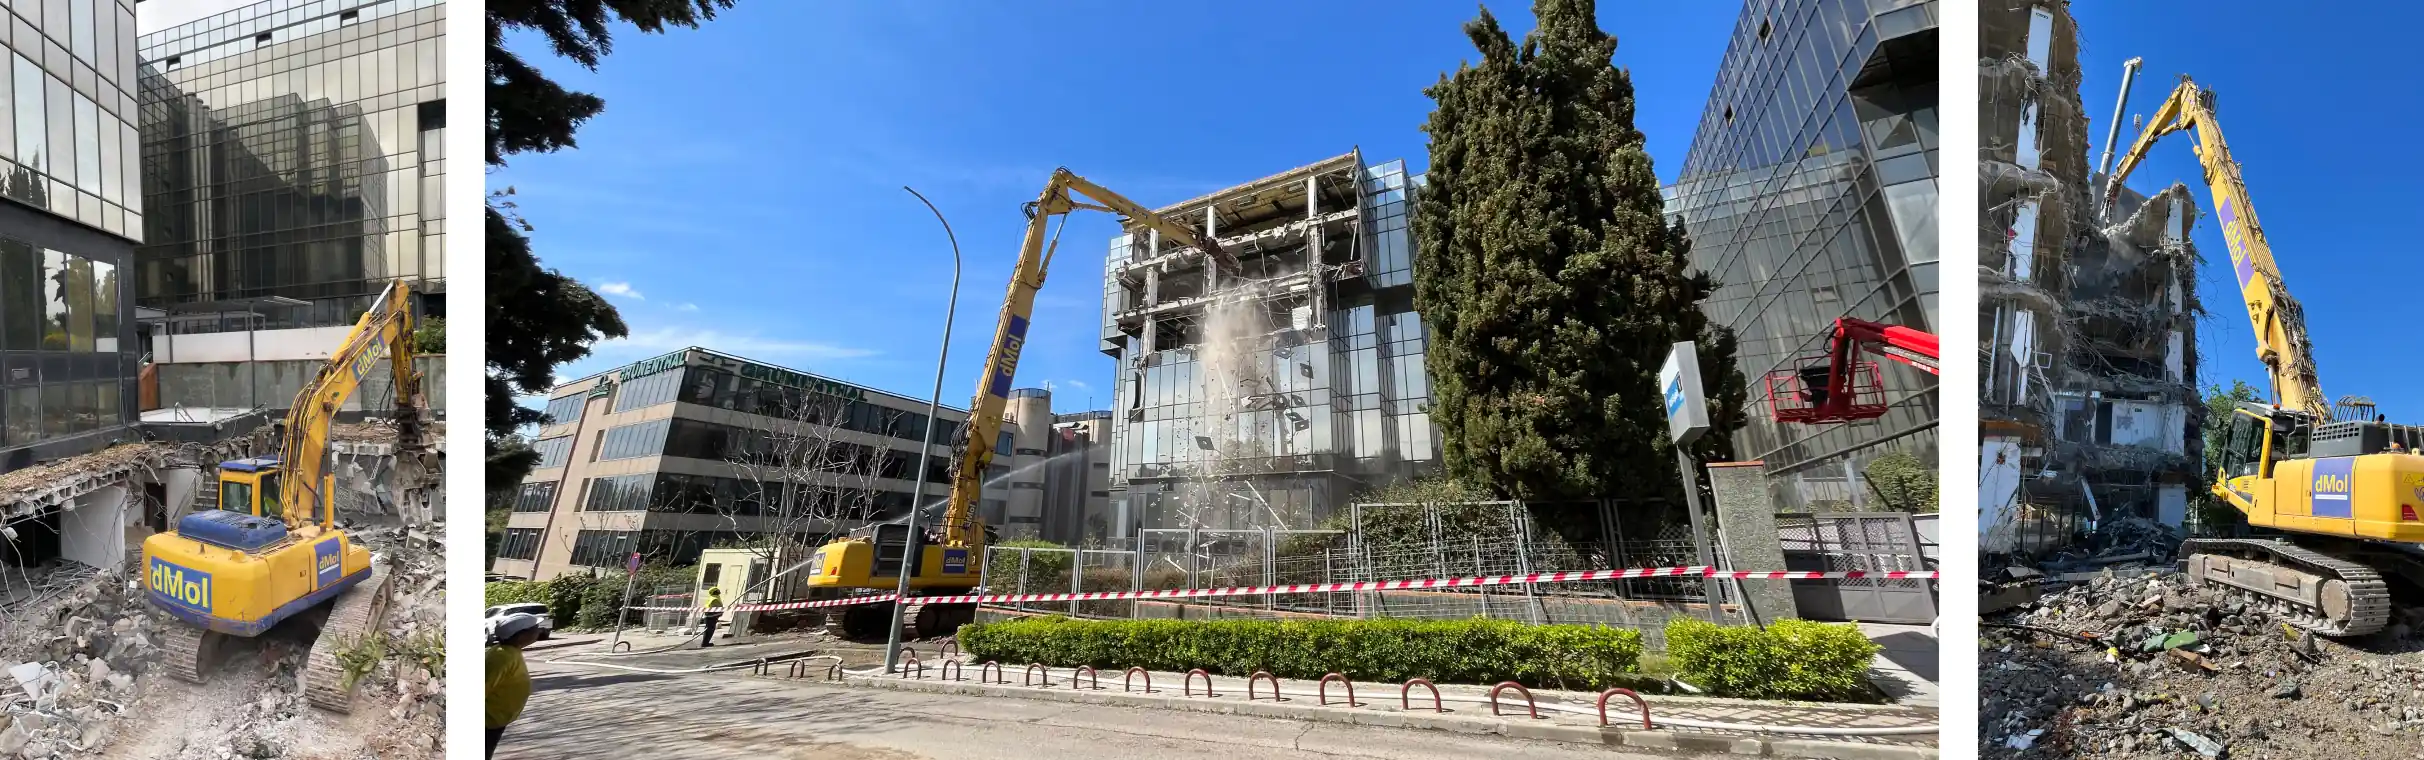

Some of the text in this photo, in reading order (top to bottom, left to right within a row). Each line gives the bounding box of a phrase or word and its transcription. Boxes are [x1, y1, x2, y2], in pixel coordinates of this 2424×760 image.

[2225, 218, 2248, 268] dMol
[357, 336, 383, 376] dMol
[1000, 334, 1022, 377] dMol
[2315, 473, 2349, 493] dMol
[319, 550, 340, 570] dMol
[946, 556, 966, 564] dMol
[151, 563, 209, 608] dMol
